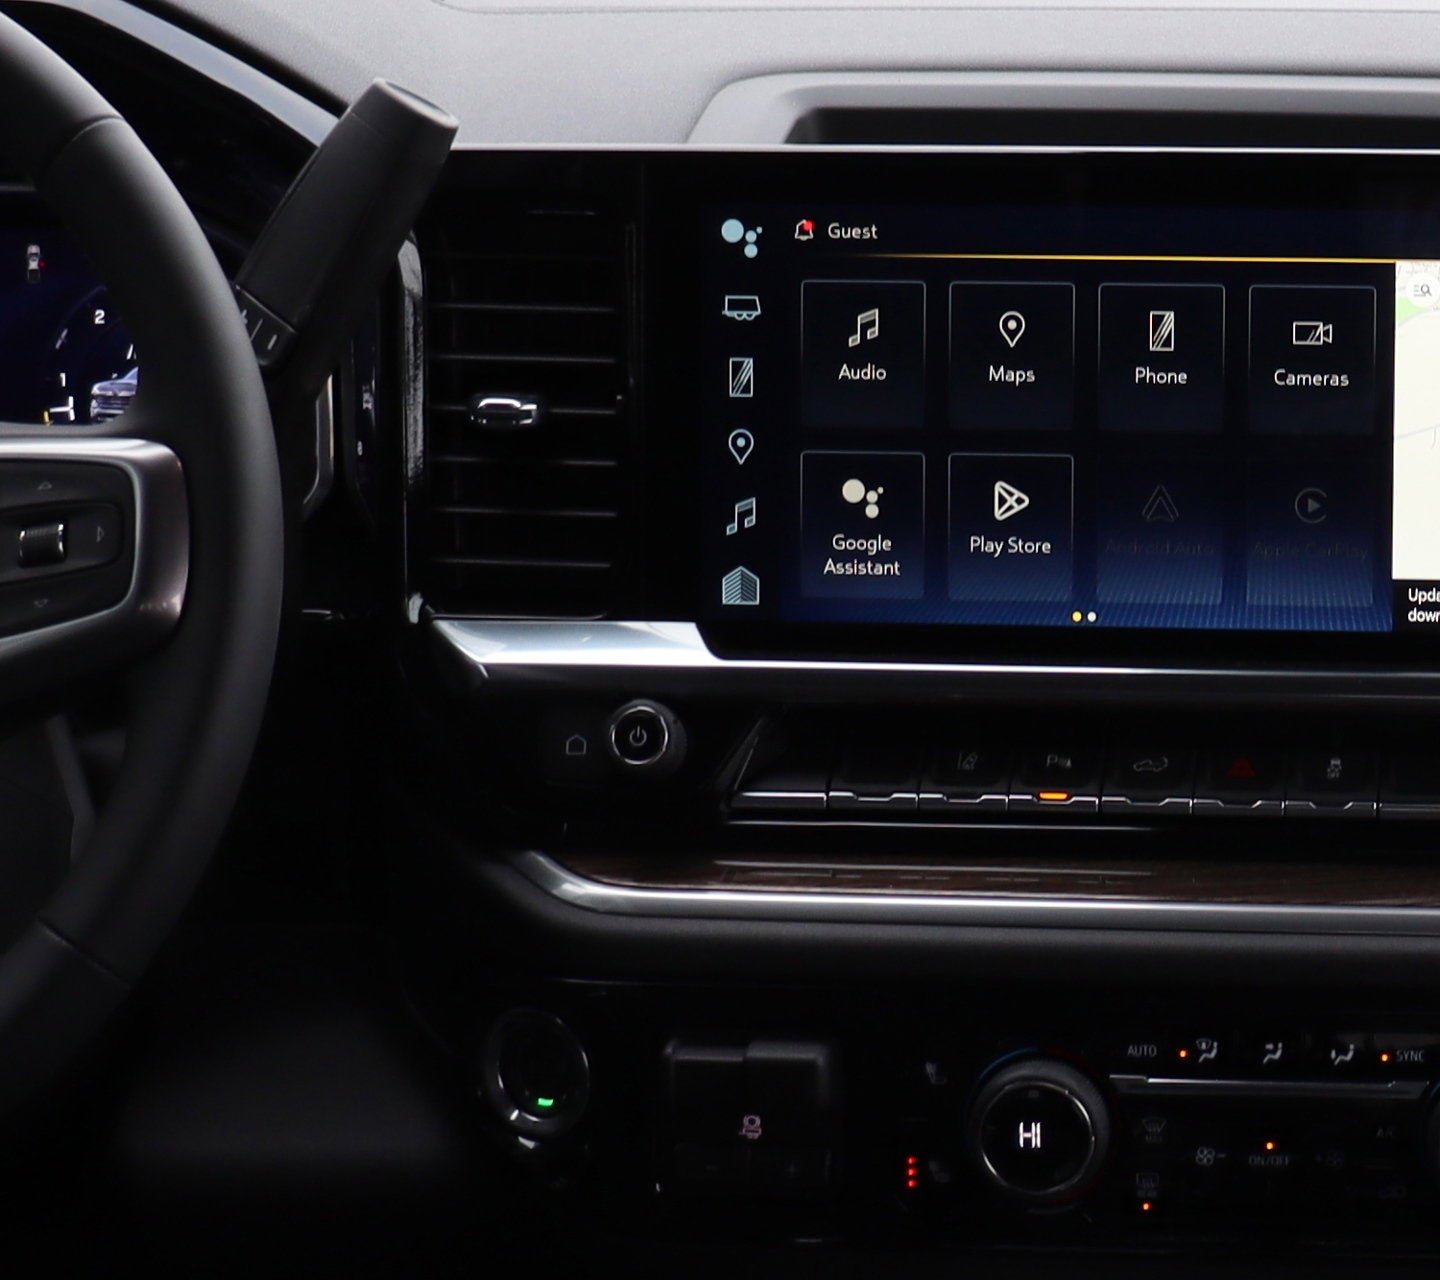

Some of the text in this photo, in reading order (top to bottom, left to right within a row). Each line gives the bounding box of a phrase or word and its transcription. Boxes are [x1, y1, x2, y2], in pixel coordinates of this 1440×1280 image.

[827, 222, 879, 240] Guest
[94, 309, 106, 325] 2
[838, 363, 888, 381] Audio
[988, 365, 1036, 387] Maps
[1135, 366, 1188, 385] Phone
[1274, 369, 1350, 387] Cameras
[832, 534, 893, 556] Google
[970, 536, 1052, 558] Play Store
[823, 558, 901, 576] Assistant
[1127, 1045, 1158, 1058] AUTO
[1395, 1050, 1426, 1064] SYNC
[1018, 1122, 1042, 1150] HI
[1248, 1153, 1293, 1167] ON/OFF
